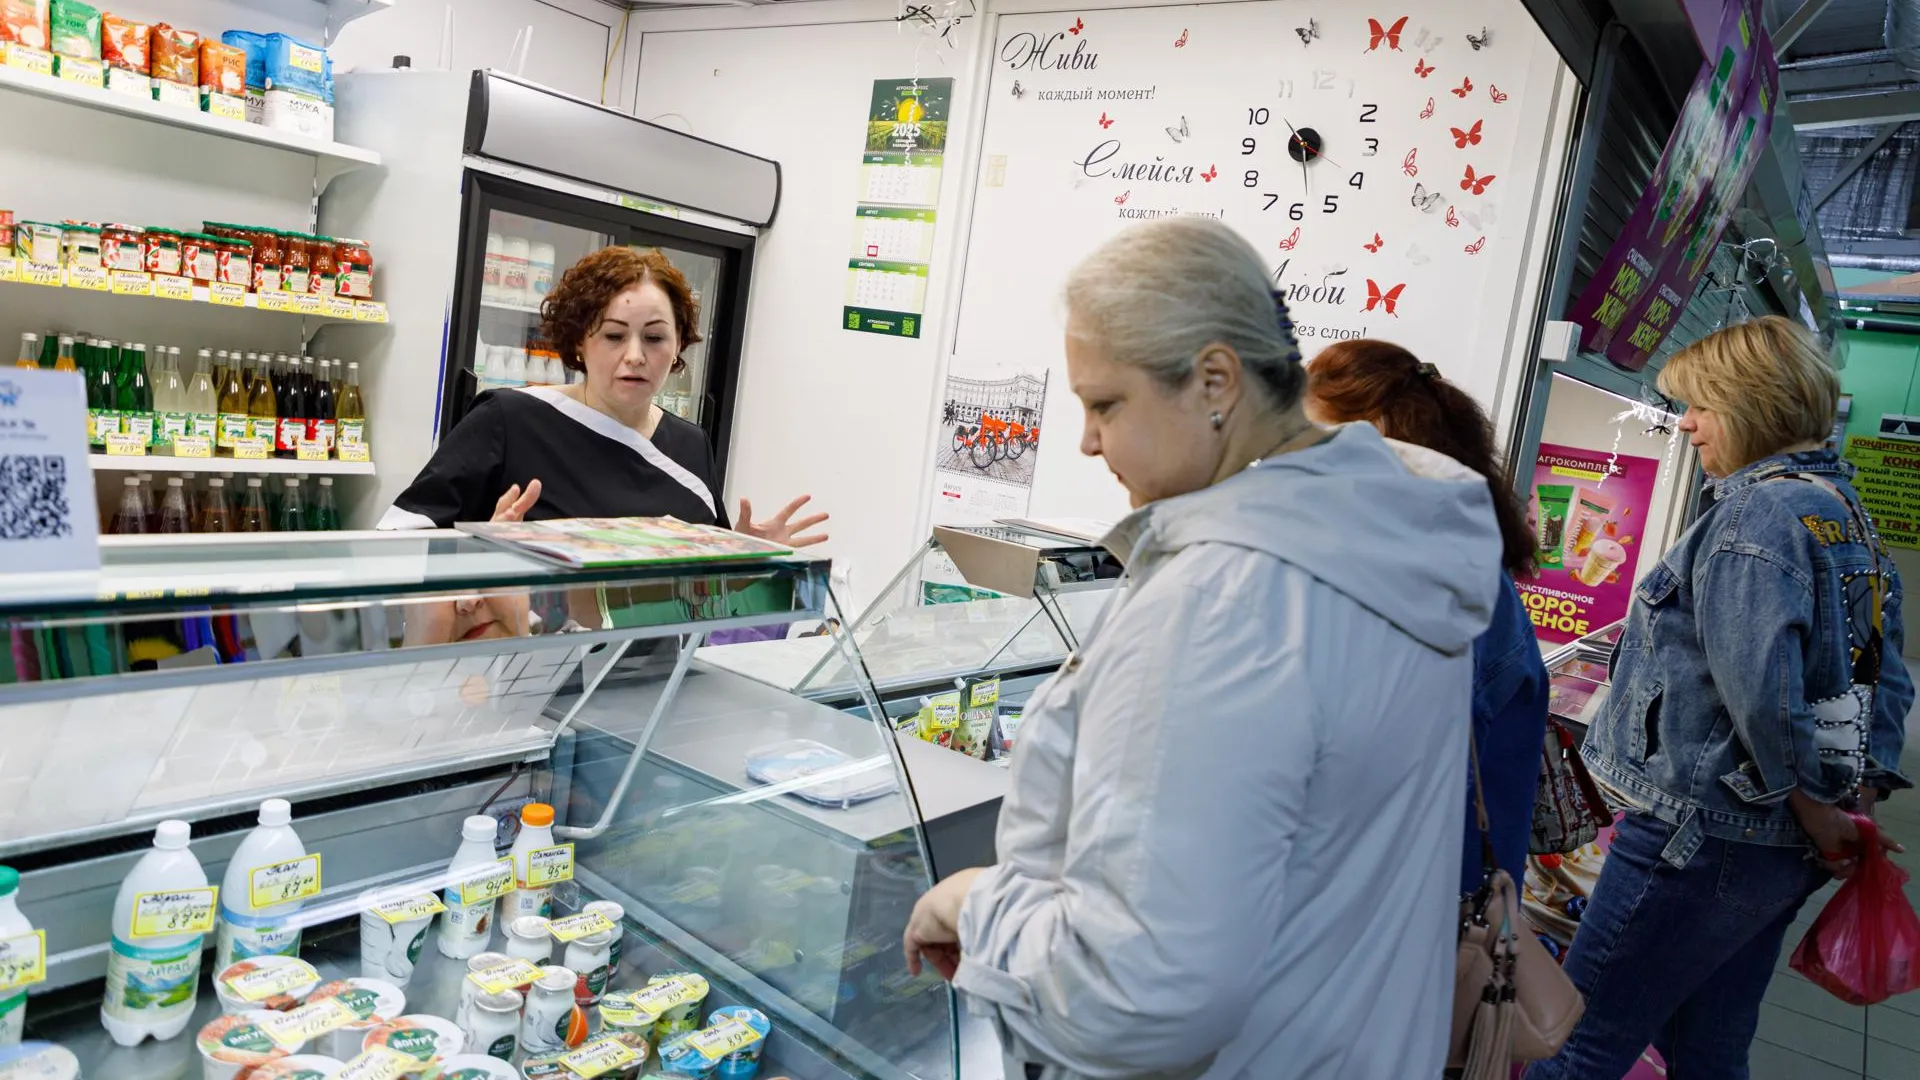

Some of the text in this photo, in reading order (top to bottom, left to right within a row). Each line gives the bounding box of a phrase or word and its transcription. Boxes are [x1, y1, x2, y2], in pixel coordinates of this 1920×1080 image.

[1001, 31, 1099, 72] Живи
[221, 55, 242, 68] РИС
[1278, 79, 1294, 98] 11
[1312, 70, 1336, 90] 12
[1348, 79, 1355, 98] 1
[1038, 86, 1157, 101] каждый момент!
[288, 99, 320, 115] МУКА
[1359, 104, 1378, 123] 2
[1248, 107, 1270, 126] 10
[892, 123, 921, 137] 2025
[1241, 137, 1256, 155] 9
[1362, 137, 1379, 156] 3
[1073, 139, 1194, 183] Смейся
[1243, 170, 1259, 188] 8
[1348, 171, 1364, 190] 4
[1262, 193, 1279, 211] 7
[1322, 195, 1339, 213] 5
[1288, 203, 1304, 221] 6
[1320, 326, 1367, 340] слов!
[1513, 581, 1595, 605] СЧАСТЛИВОЧНОЕ
[1525, 608, 1590, 636] ЕНОЕ
[486, 881, 502, 896] 94
[167, 912, 192, 929] 87
[260, 933, 283, 943] ТАН
[393, 1034, 433, 1049] ЙОГУРТ
[727, 1033, 743, 1047] 89
